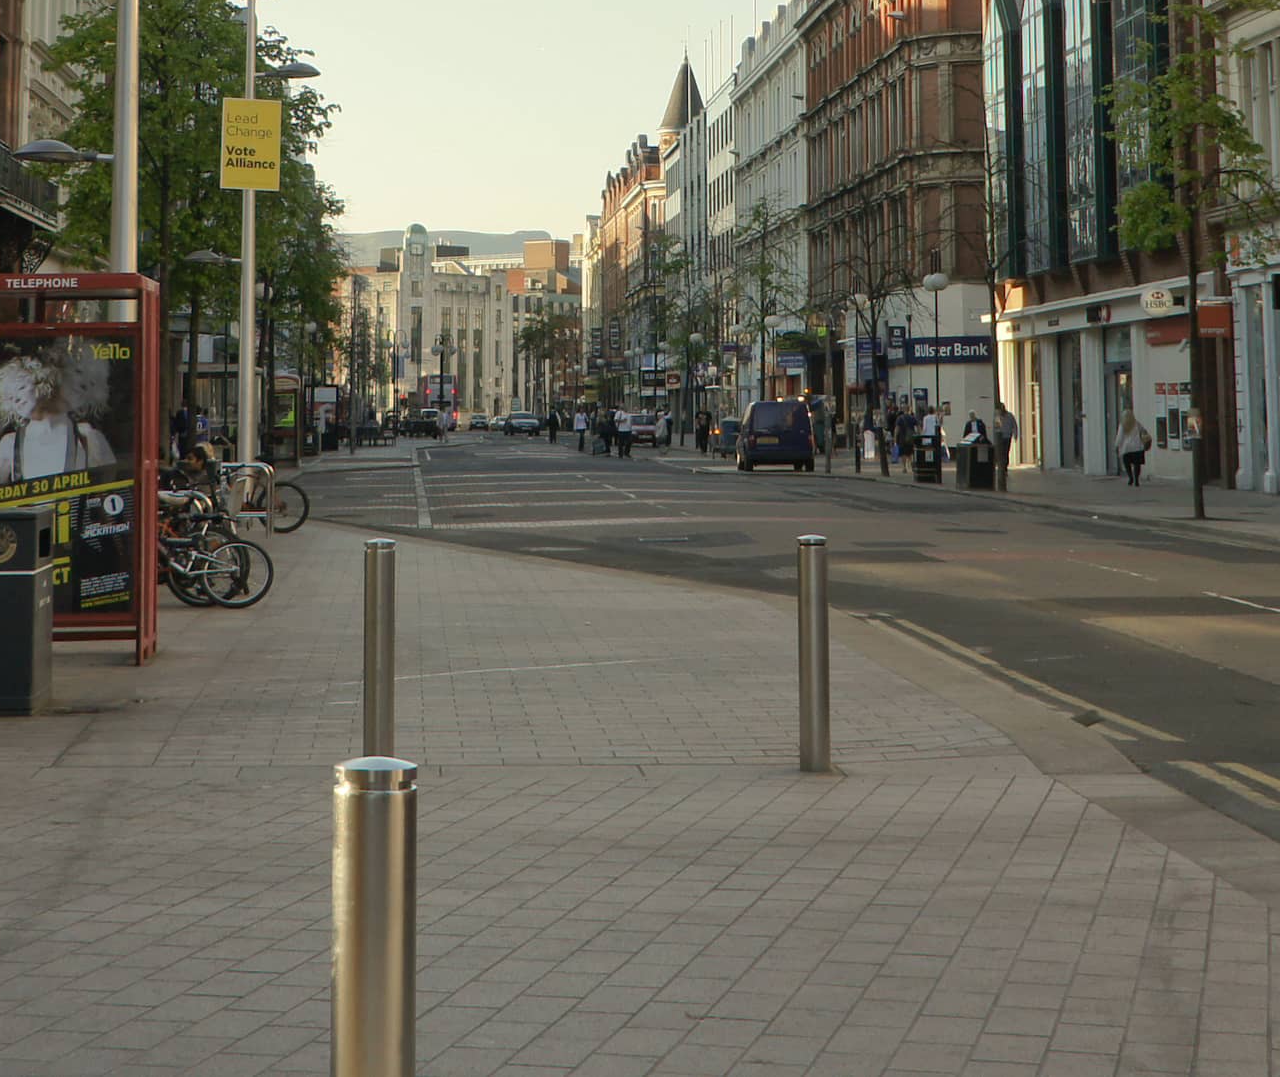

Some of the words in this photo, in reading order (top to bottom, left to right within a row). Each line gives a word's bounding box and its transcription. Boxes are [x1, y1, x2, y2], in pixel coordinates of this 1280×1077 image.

[226, 112, 259, 124] Lead
[225, 125, 273, 140] Change
[225, 144, 257, 157] Vote
[225, 157, 276, 170] Alliance
[5, 277, 79, 289] TELEPHONE
[1145, 300, 1172, 309] HSBC
[90, 343, 131, 361] Yello
[954, 342, 988, 356] Bank
[32, 479, 50, 494] 30
[53, 472, 91, 490] APRIL
